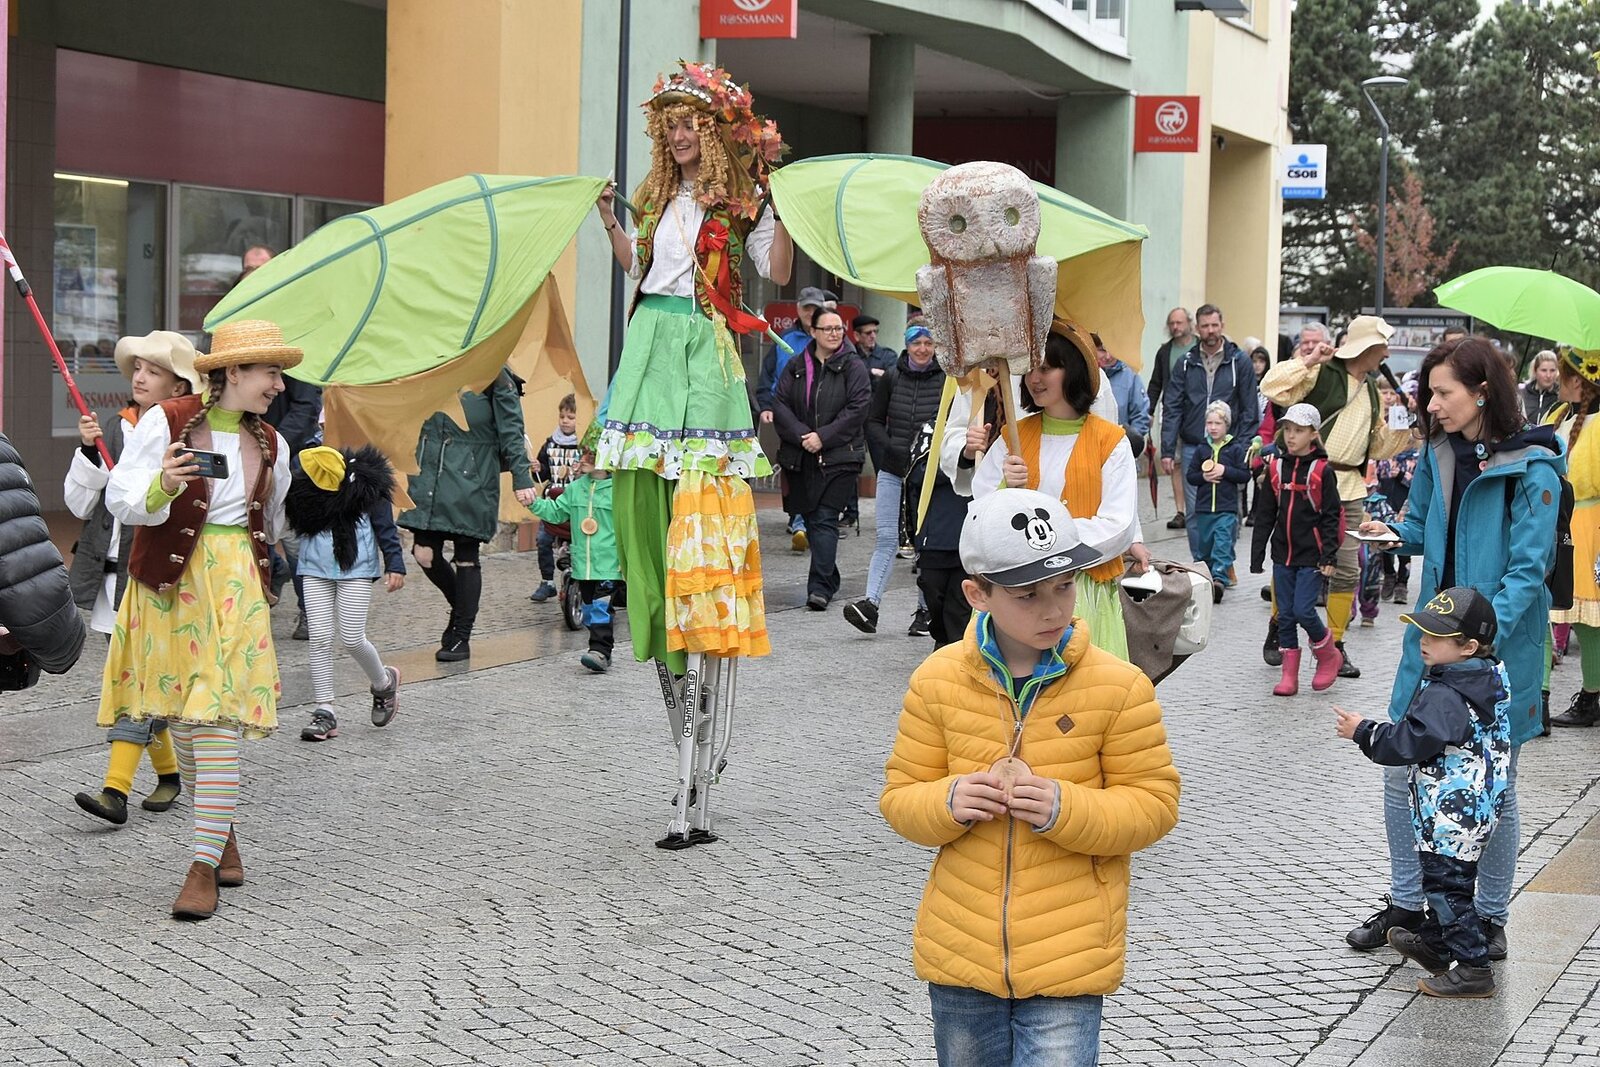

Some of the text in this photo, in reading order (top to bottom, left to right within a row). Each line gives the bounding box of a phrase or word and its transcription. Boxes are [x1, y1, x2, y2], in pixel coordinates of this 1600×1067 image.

[719, 13, 784, 25] ROSSMANN
[1147, 136, 1194, 145] ROSSMANN
[66, 391, 132, 409] RSSMANN
[684, 672, 697, 735] SILVERWALK
